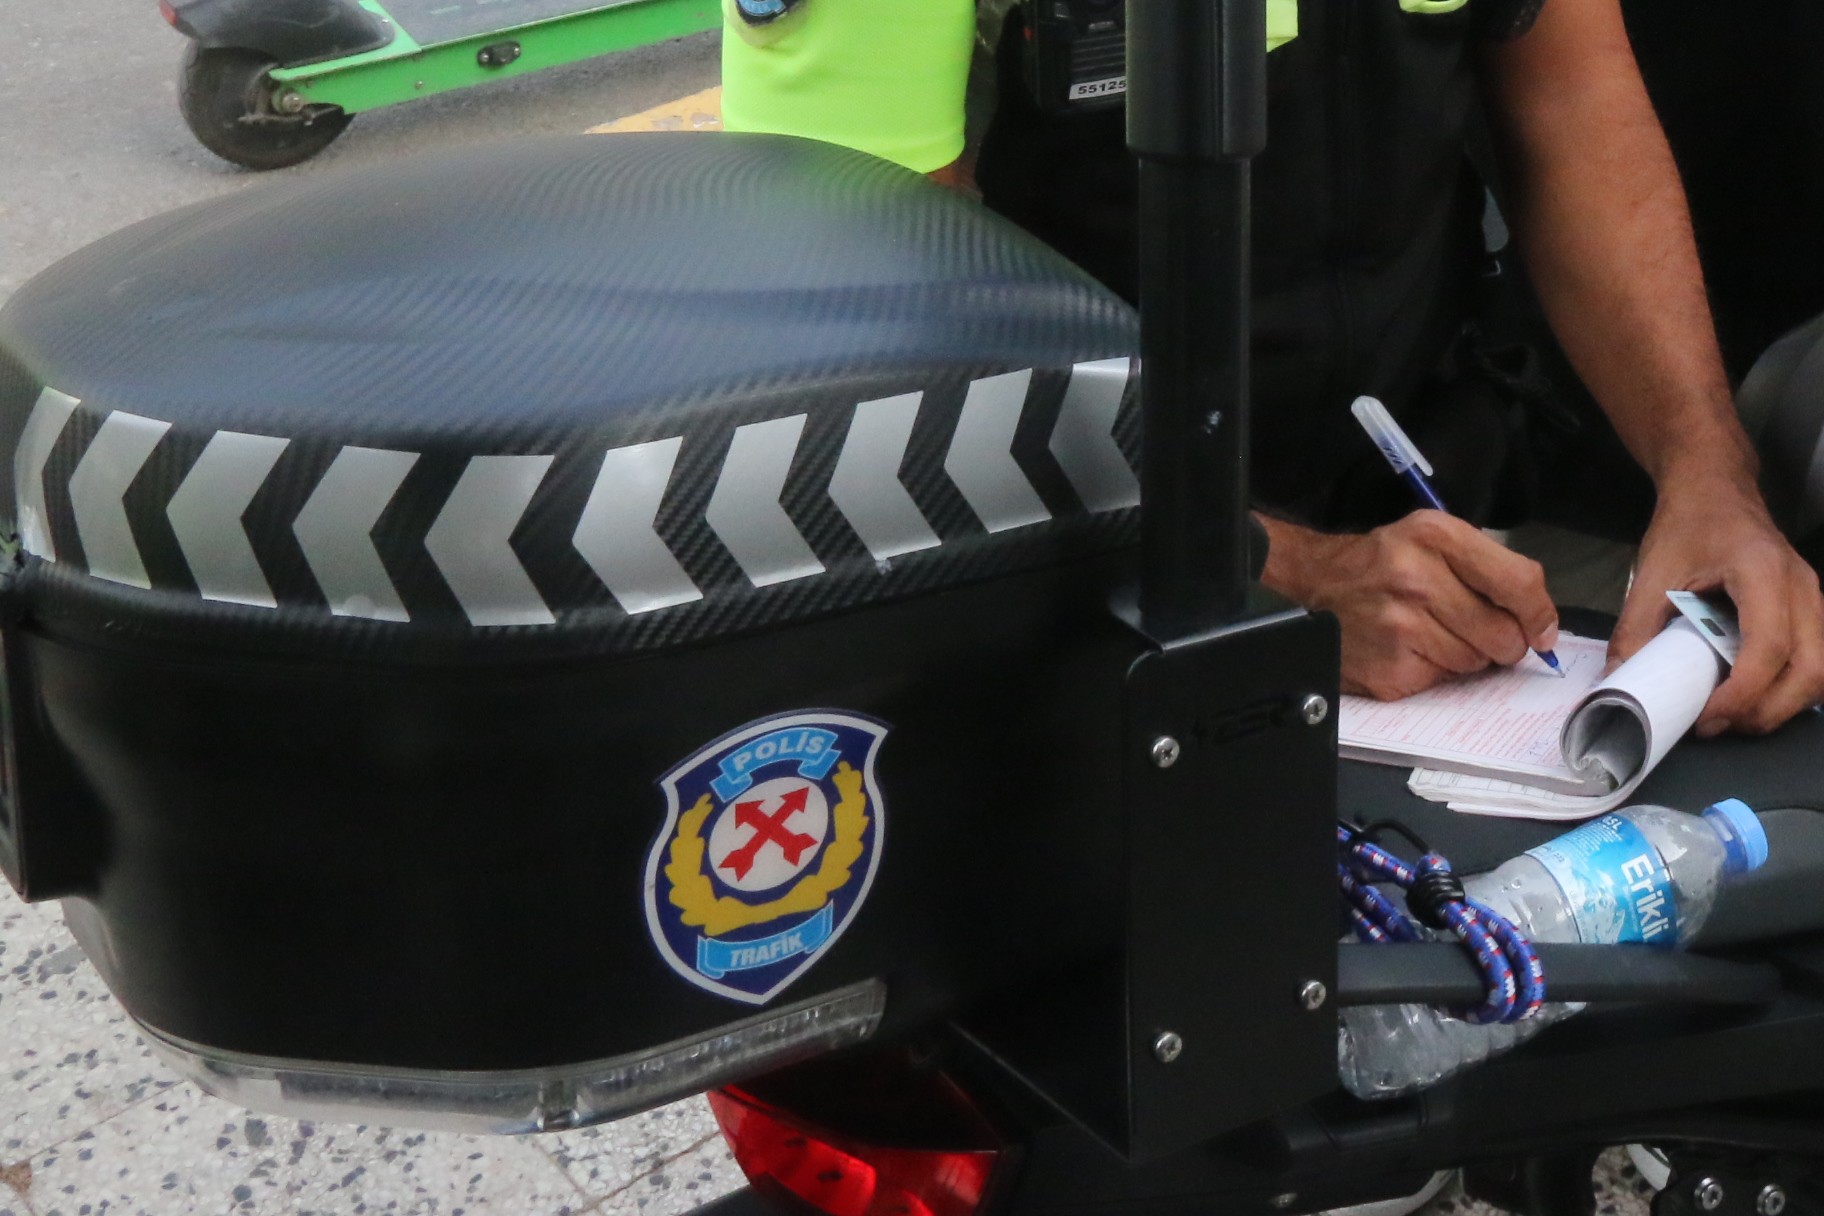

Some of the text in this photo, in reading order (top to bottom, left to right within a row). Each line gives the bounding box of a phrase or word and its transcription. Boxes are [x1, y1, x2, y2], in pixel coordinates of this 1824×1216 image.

[732, 732, 825, 772] POLİS
[1620, 853, 1670, 940] Erikli
[729, 931, 805, 967] TRAFİK
